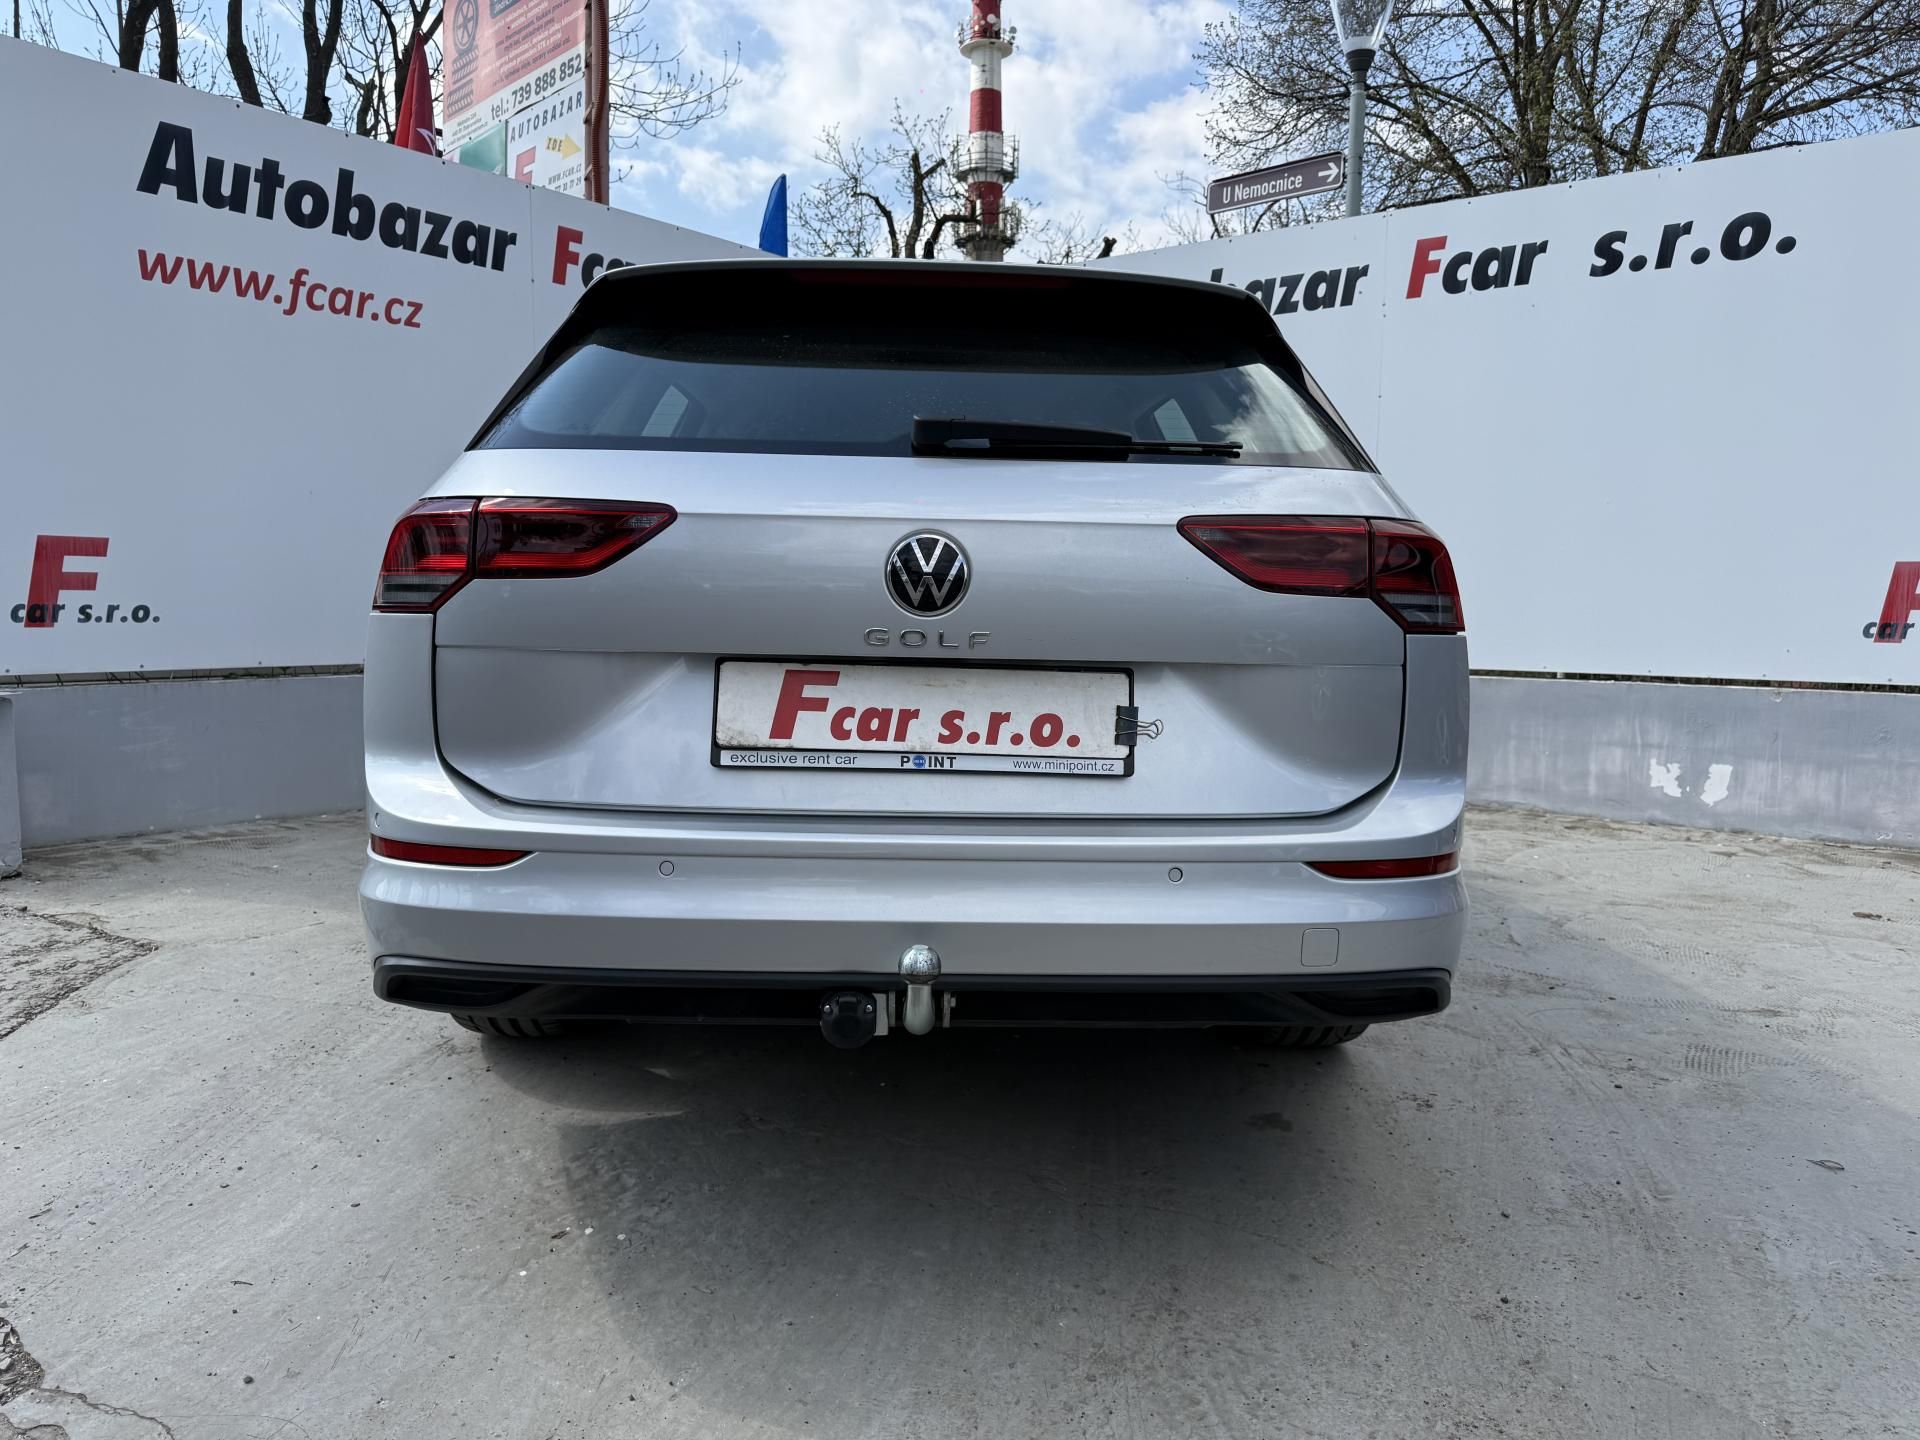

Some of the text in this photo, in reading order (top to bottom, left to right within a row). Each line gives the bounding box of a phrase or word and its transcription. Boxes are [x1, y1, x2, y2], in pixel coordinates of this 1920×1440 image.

[491, 98, 509, 121] tel.:
[511, 82, 531, 110] 739
[534, 68, 557, 96] 888
[559, 53, 582, 81] 852
[510, 91, 582, 144] AUTOBAZAR
[546, 137, 562, 152] ZDE
[1223, 173, 1303, 204] U Nemocnice
[135, 120, 638, 289] Autobazar Fc
[1405, 235, 1549, 299] Fcar
[1589, 211, 1798, 278] s.r.o.
[137, 248, 425, 329] www.fcar.cz
[10, 603, 160, 623] car s.r.o.
[863, 627, 992, 650] GOLF
[1862, 621, 1915, 640] car
[938, 710, 1081, 748] s.r.o.
[730, 752, 858, 765] exclusive rent car
[1013, 760, 1115, 773] www.minipoint.cz
